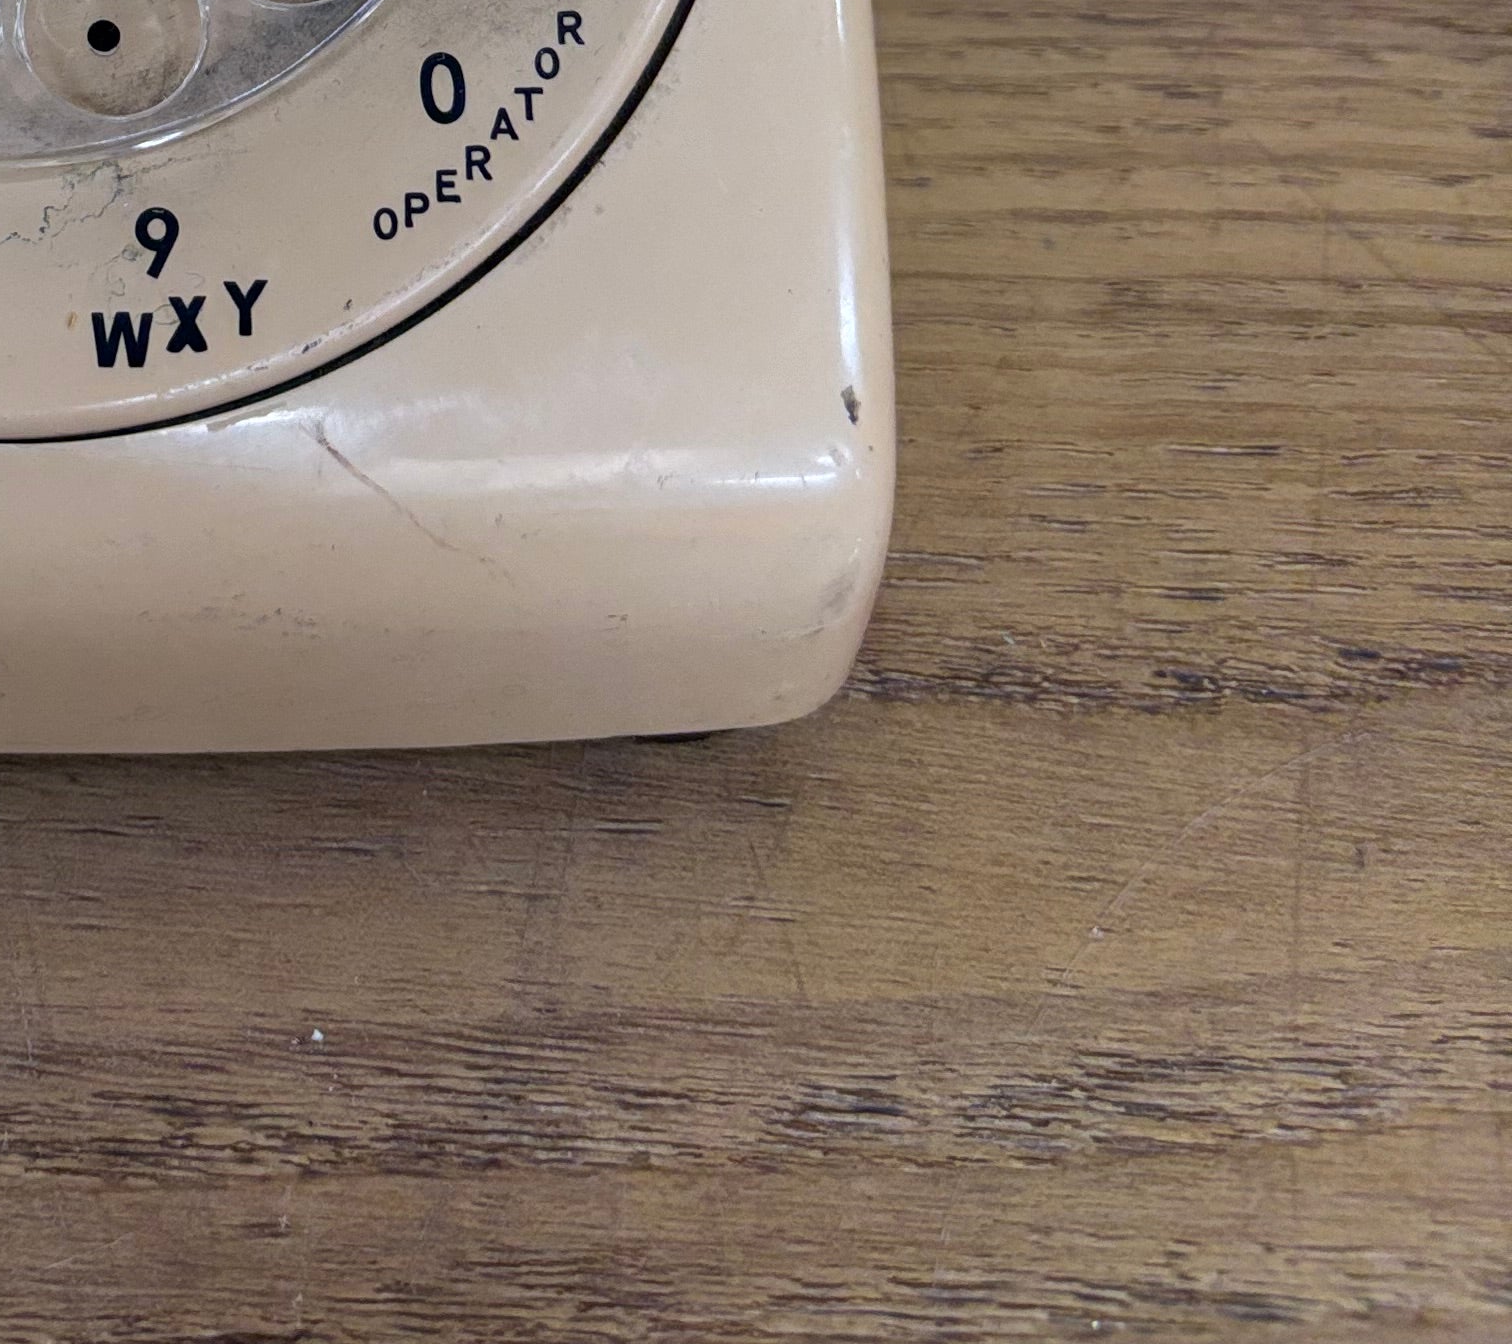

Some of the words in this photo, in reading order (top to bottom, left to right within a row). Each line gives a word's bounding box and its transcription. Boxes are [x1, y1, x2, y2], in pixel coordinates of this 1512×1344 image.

[372, 9, 586, 242] OPERATOR
[418, 50, 467, 126] 0
[133, 205, 181, 281] 9
[90, 278, 270, 370] WXY
